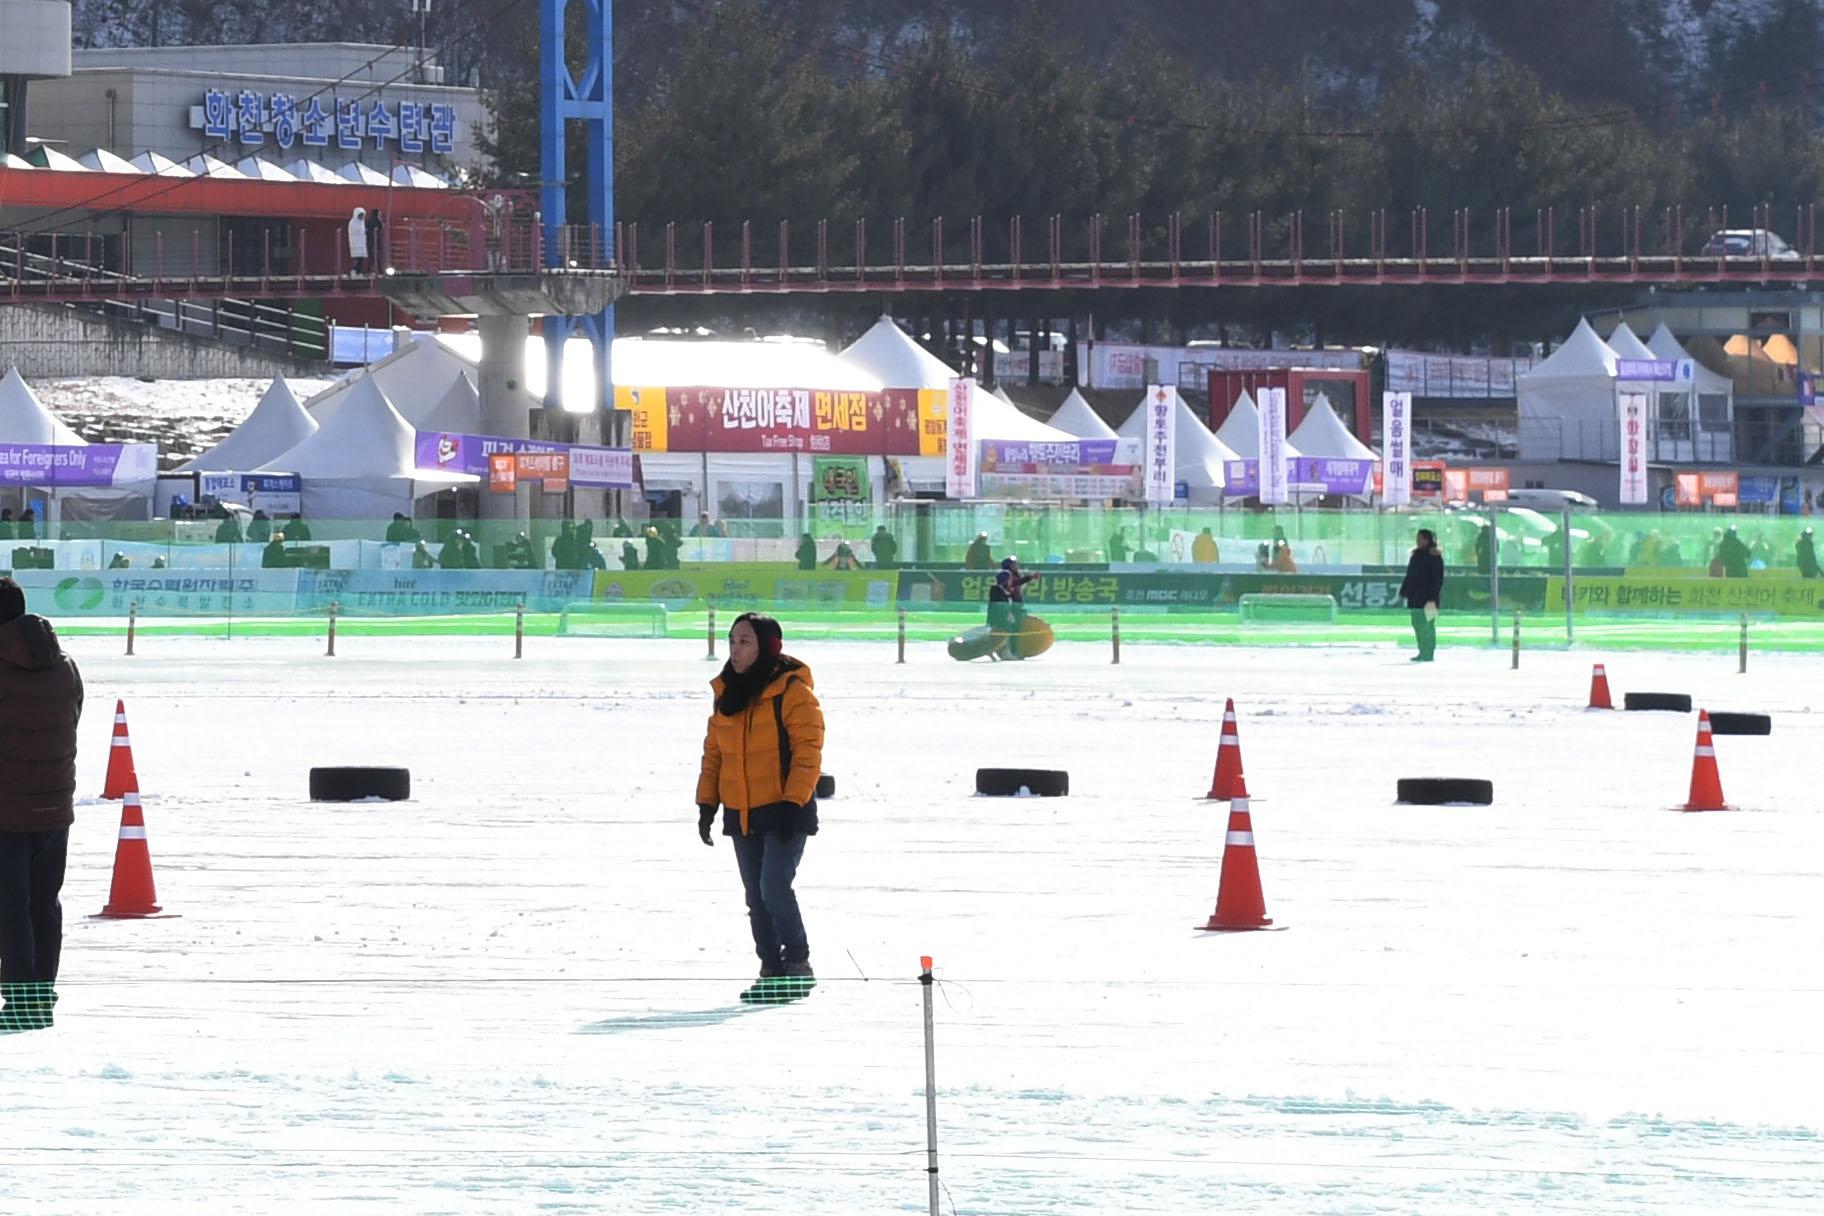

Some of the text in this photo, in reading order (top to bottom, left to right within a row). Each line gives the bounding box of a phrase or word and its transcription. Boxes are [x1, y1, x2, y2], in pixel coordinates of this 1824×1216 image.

[205, 88, 457, 154] 화천청소년수련관
[721, 389, 868, 432] 산천어축제 면세점
[1153, 404, 1169, 483] 향토주전부리
[1389, 398, 1404, 479] 얼음썰매
[9, 448, 22, 465] for
[23, 449, 68, 470] Foreigners
[69, 449, 87, 470] Only
[358, 591, 407, 607] EXTRA
[410, 591, 450, 607] COLD
[1053, 577, 1119, 604] 방송국
[1615, 584, 1682, 606] 함께하는
